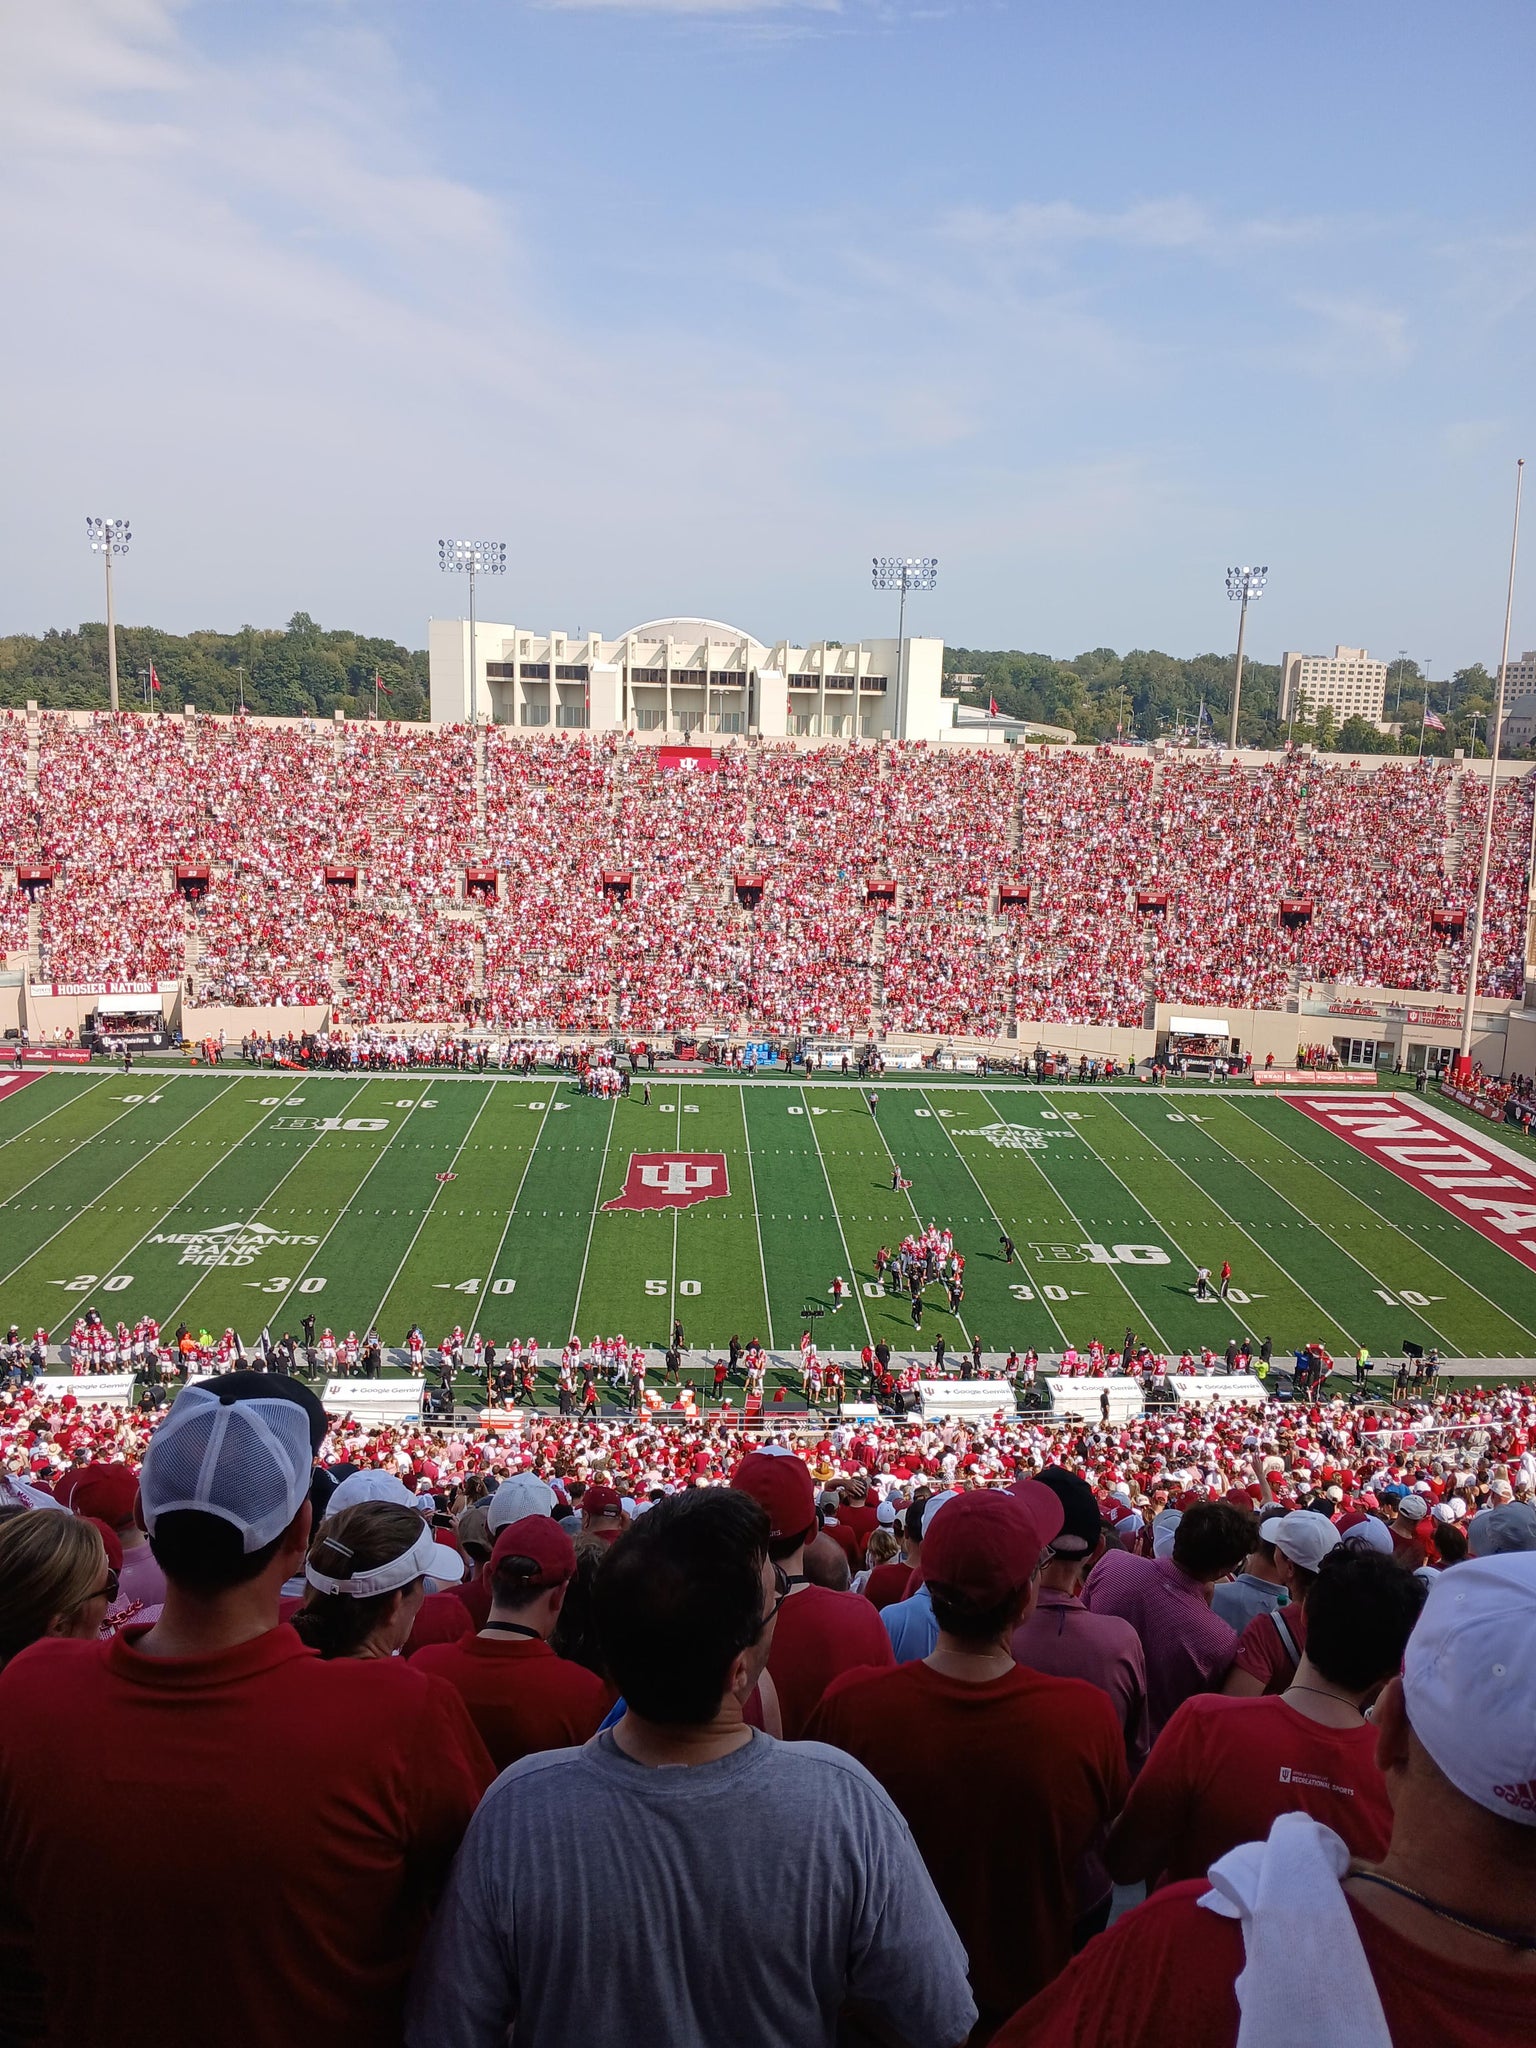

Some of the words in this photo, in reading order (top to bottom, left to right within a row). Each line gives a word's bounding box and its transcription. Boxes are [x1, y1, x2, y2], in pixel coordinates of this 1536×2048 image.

[58, 983, 106, 995] HOOSIER
[110, 982, 152, 993] NATION
[659, 1104, 700, 1113] 50
[951, 1129, 1076, 1139] MERCHANTS
[985, 1135, 1048, 1143] BANK
[993, 1141, 1049, 1149] FIELD
[1304, 1100, 1536, 1258] INDIA
[147, 1233, 320, 1246] MERCHANTS
[182, 1244, 269, 1255] BANK
[177, 1254, 255, 1267] FIELD
[64, 1274, 134, 1291] 20
[262, 1277, 328, 1293] 30
[454, 1278, 517, 1295] 40
[645, 1279, 701, 1295] 50
[1008, 1284, 1069, 1301] 30
[1372, 1289, 1431, 1306] 10
[1291, 1775, 1331, 1789] RECREATIONAL
[1331, 1784, 1355, 1796] SPORTS
